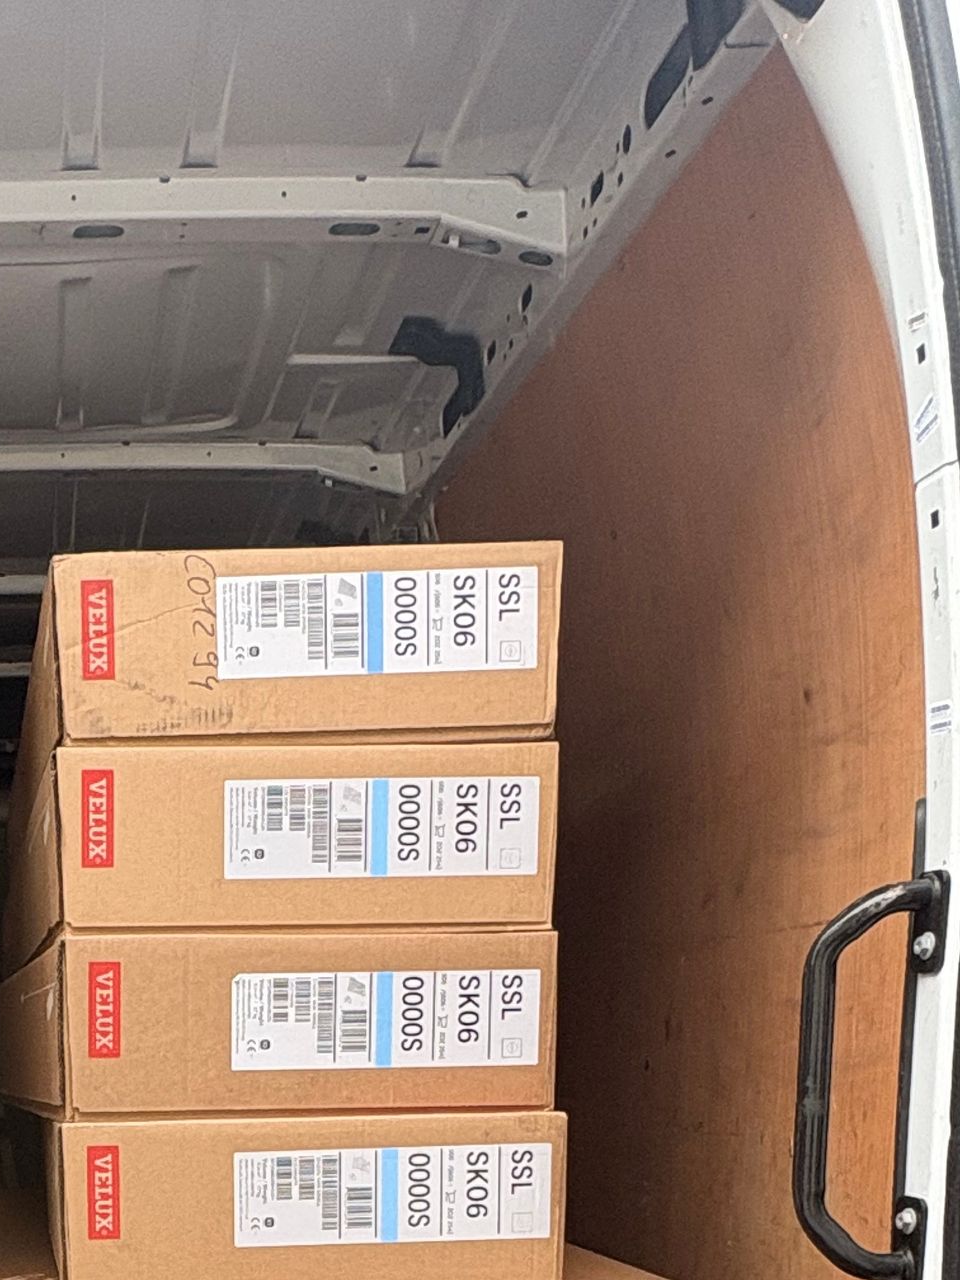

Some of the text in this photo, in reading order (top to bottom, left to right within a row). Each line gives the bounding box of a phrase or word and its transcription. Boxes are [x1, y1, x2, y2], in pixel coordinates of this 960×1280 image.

[87, 589, 109, 674] VELUX
[393, 577, 417, 657] 0000S
[453, 575, 476, 647] SK06
[498, 574, 521, 622] SSL
[87, 778, 108, 861] VELUX
[397, 784, 421, 862] 0000S
[454, 783, 479, 854] SK06
[499, 783, 522, 830] SSL
[94, 967, 115, 1050] VELUX
[400, 976, 425, 1052] 0000S
[457, 975, 481, 1044] SK06
[501, 974, 523, 1020] SSL
[94, 1153, 115, 1233] VELUX
[407, 1153, 431, 1228] 0000S
[466, 1151, 489, 1218] SK06
[510, 1149, 533, 1195] SSL
